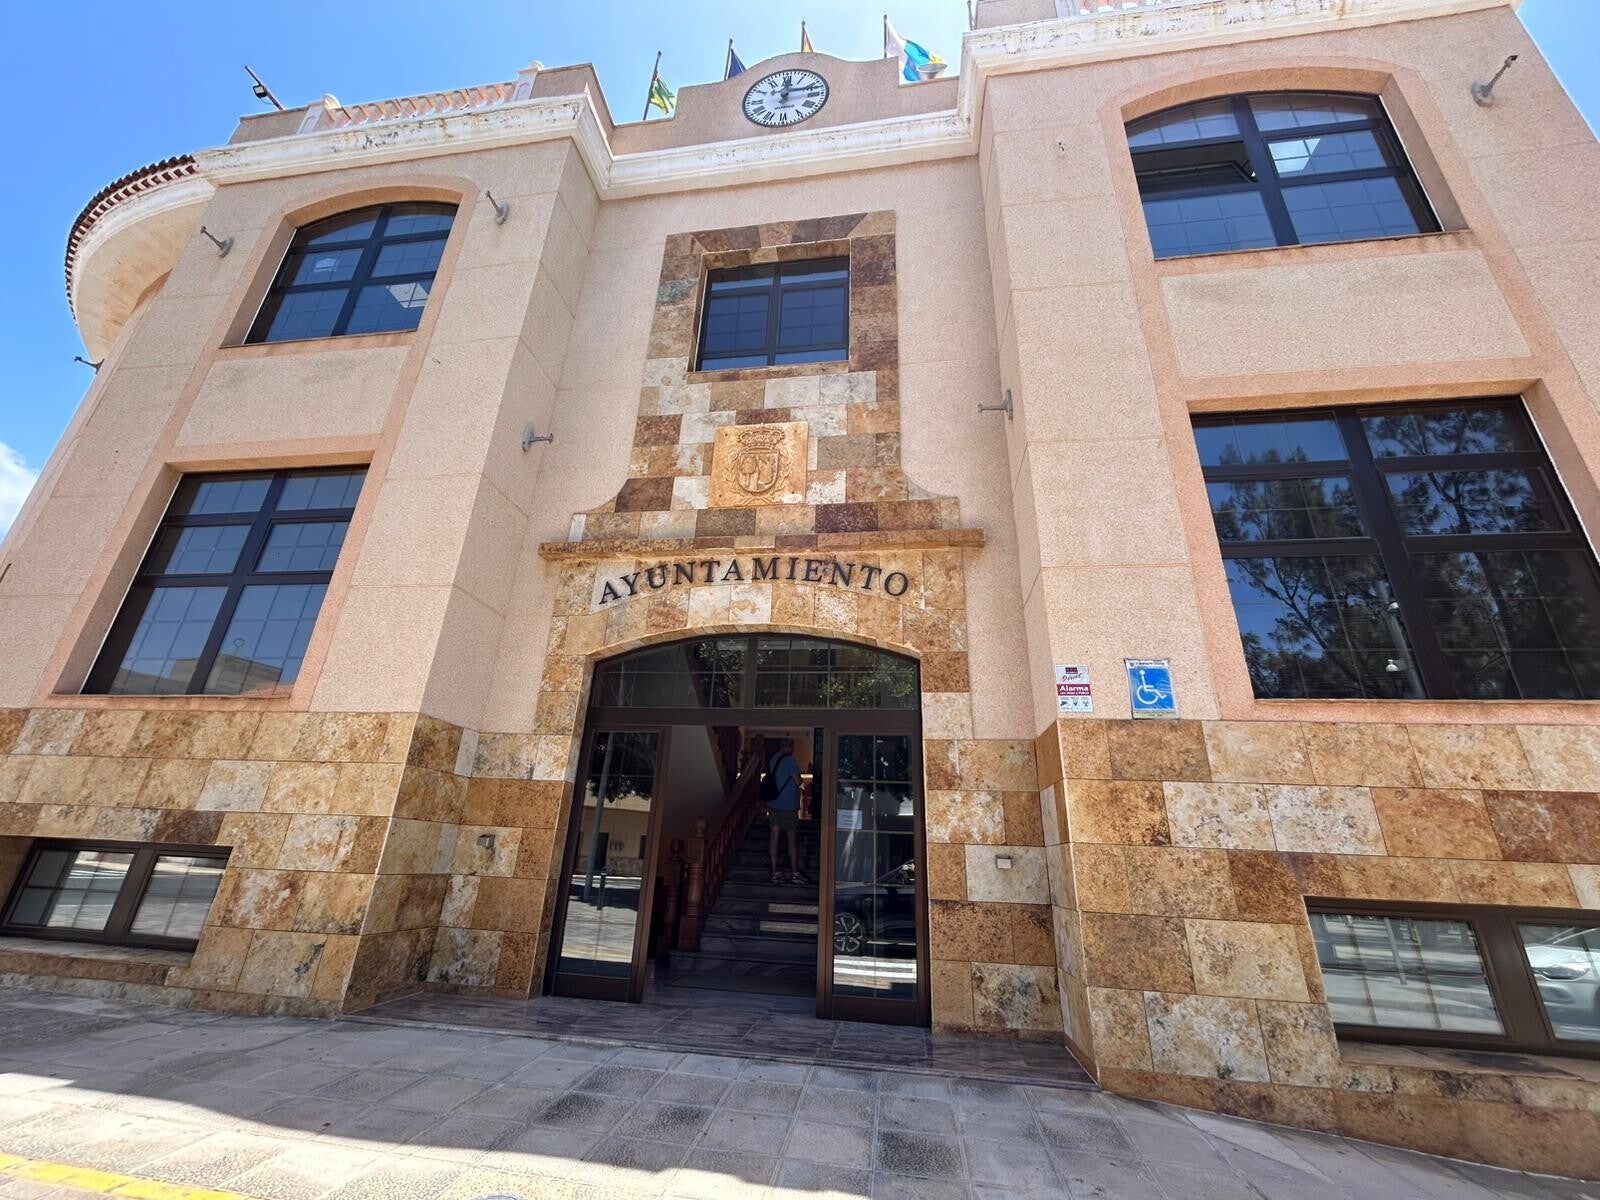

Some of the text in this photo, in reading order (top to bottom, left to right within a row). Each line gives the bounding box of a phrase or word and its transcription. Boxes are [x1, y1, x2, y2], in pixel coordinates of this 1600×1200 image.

[762, 111, 775, 121] VII
[779, 112, 787, 121] VI
[795, 109, 803, 117] V
[598, 556, 909, 605] AYUNTAMIENTO
